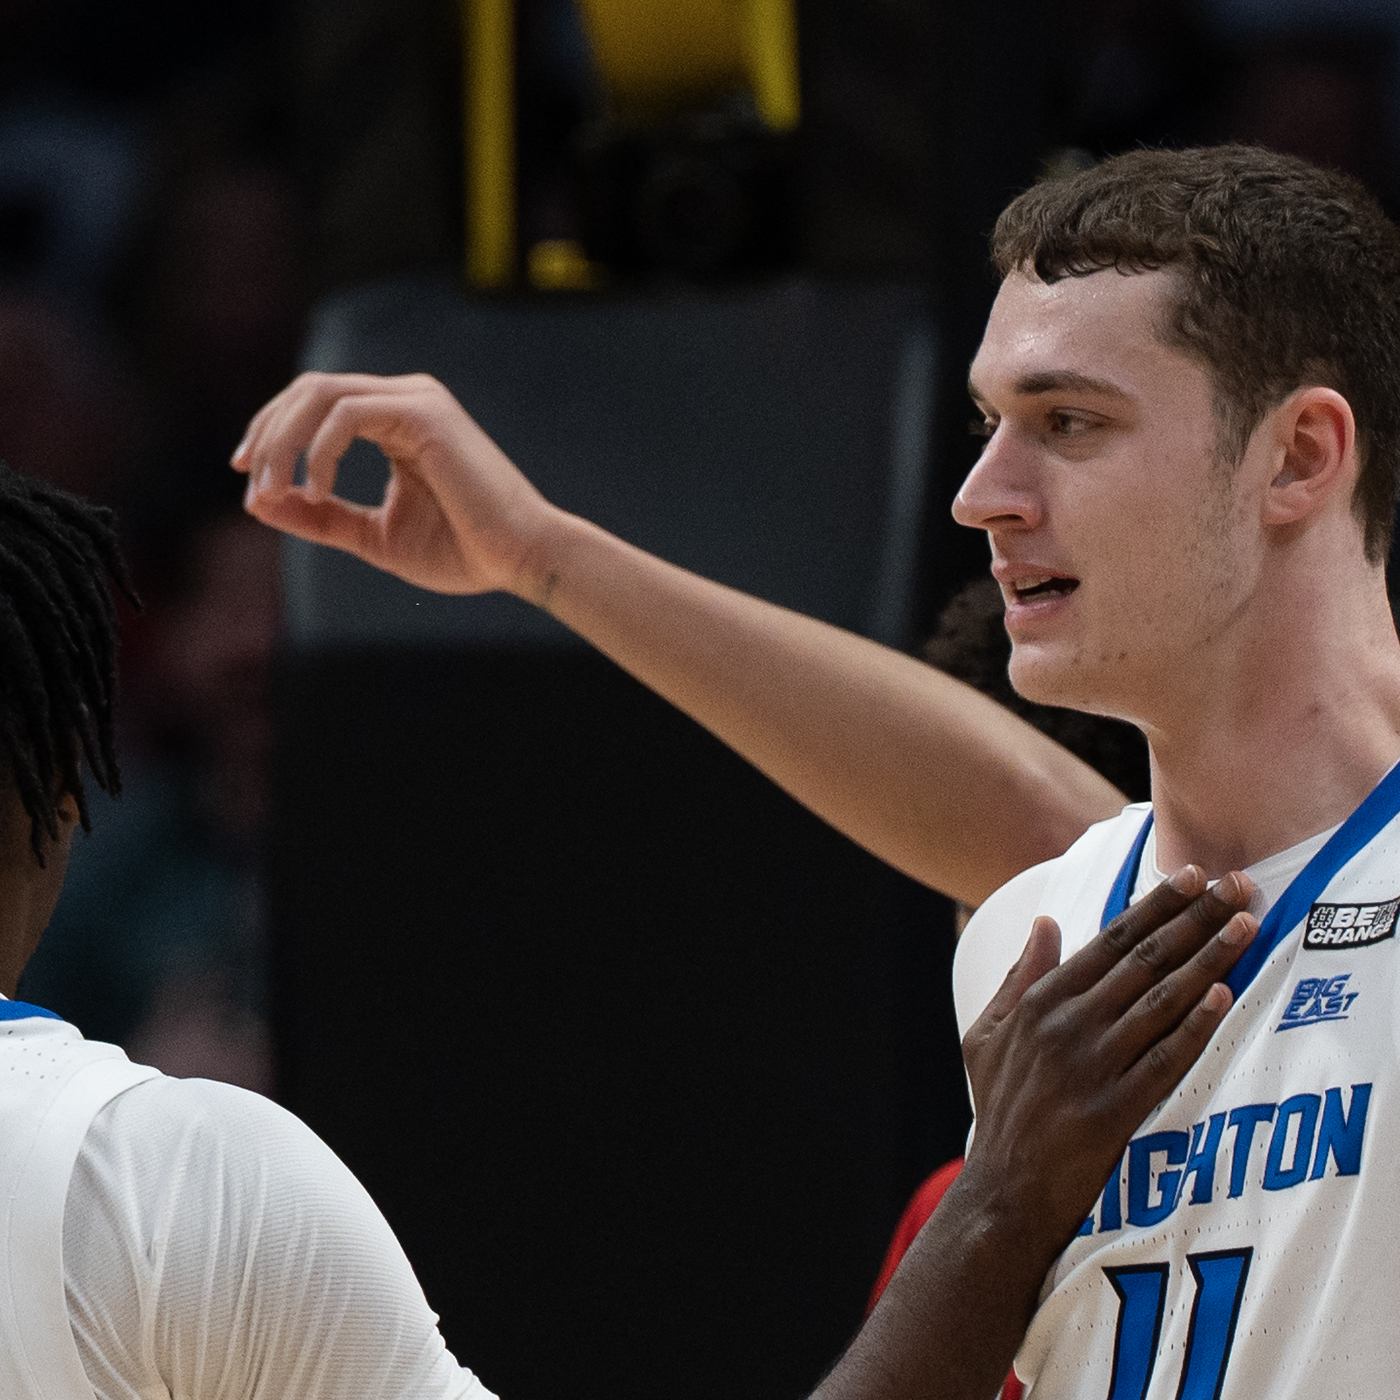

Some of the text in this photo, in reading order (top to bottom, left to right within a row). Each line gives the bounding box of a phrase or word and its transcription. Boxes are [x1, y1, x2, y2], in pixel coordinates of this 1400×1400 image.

[1307, 918, 1393, 944] CHANGE
[1292, 973, 1353, 999] BIG
[1282, 992, 1360, 1020] EAST
[1076, 1082, 1373, 1237] IGHTON
